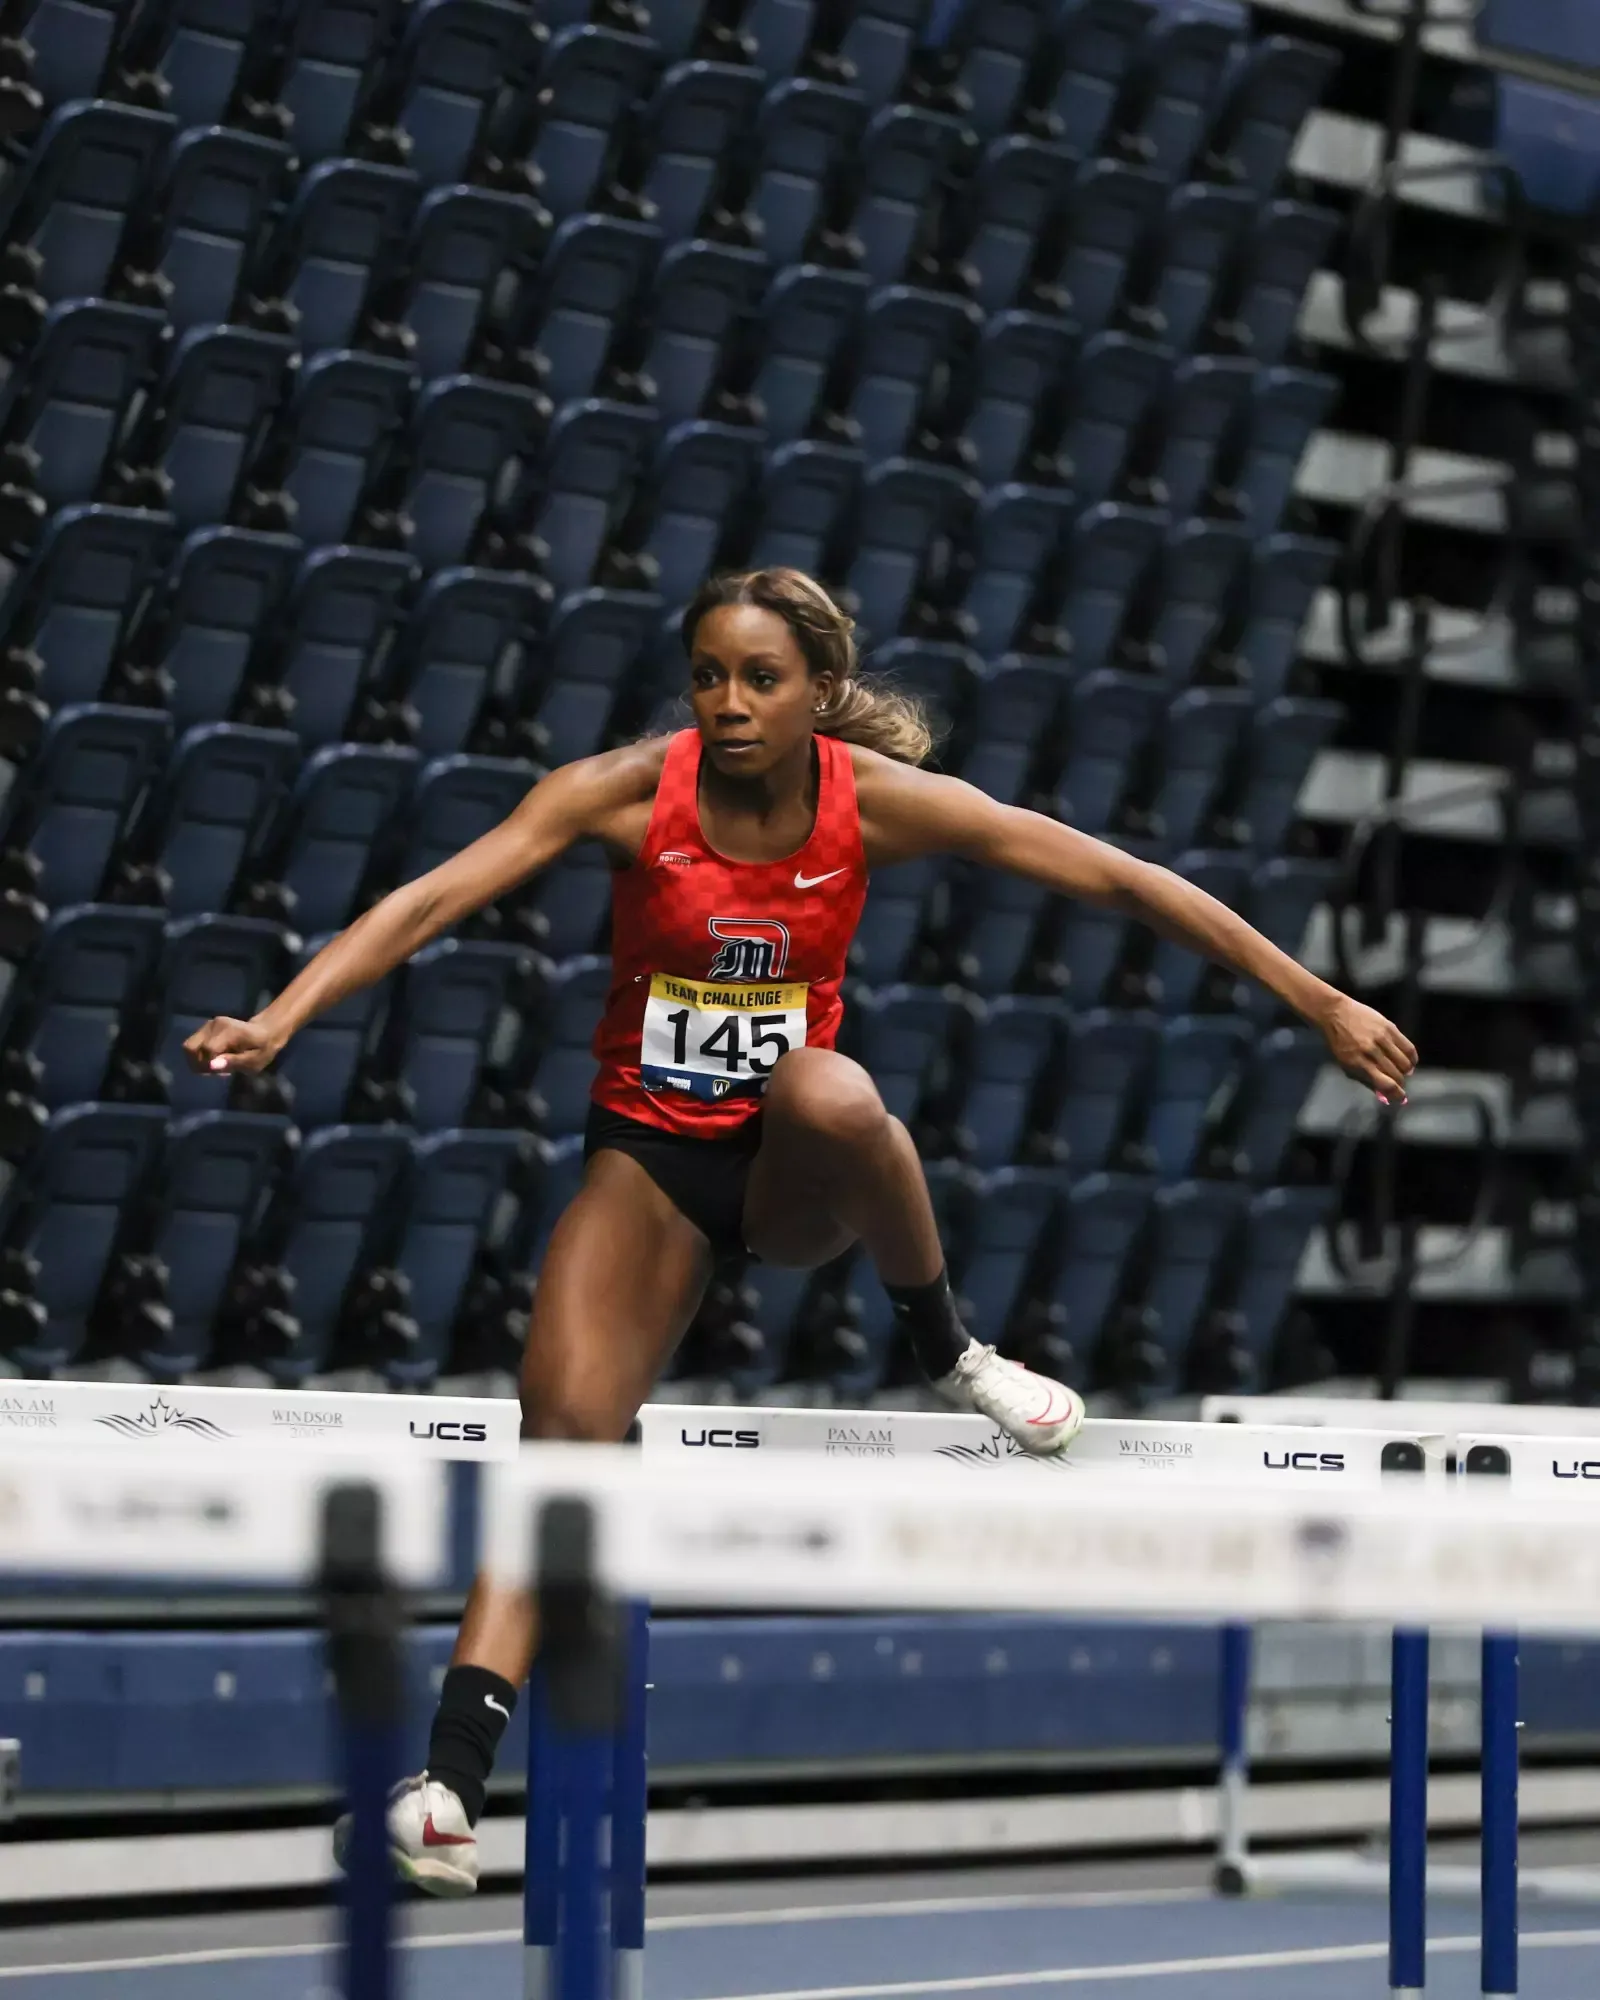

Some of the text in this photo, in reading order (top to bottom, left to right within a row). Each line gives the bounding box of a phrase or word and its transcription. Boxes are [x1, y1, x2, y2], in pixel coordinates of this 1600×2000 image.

[664, 981, 698, 1003] TEAM
[702, 990, 782, 1007] CHALLENGE
[667, 1009, 790, 1074] 145
[0, 1398, 54, 1412] AN AM
[271, 1409, 343, 1424] WINDSOR
[408, 1421, 488, 1442] UCS
[681, 1429, 760, 1449] UCS
[828, 1428, 892, 1443] PAN AM
[1118, 1440, 1194, 1454] WINDSOR
[1263, 1451, 1345, 1471] UCS
[1552, 1460, 1600, 1480] UC
